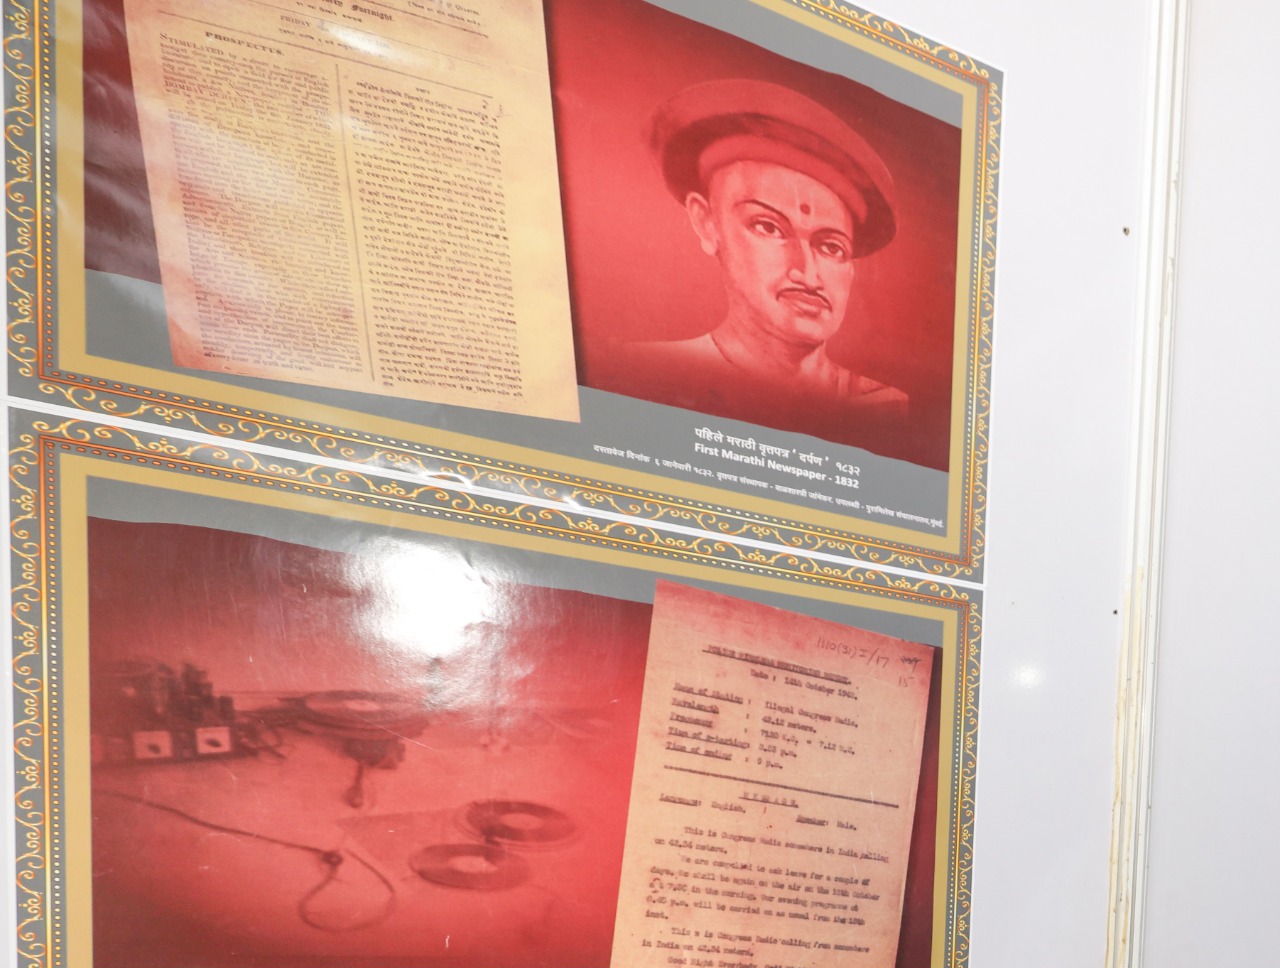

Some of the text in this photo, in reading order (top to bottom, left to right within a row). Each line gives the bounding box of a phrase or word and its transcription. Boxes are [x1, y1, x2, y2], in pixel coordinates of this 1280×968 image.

[694, 427, 724, 443] पहिले
[726, 435, 757, 451] मराठी
[758, 443, 790, 458] वृत्तपत्र
[836, 462, 860, 476] १८३२
[695, 442, 859, 489] First Marathi Newspaper 1832
